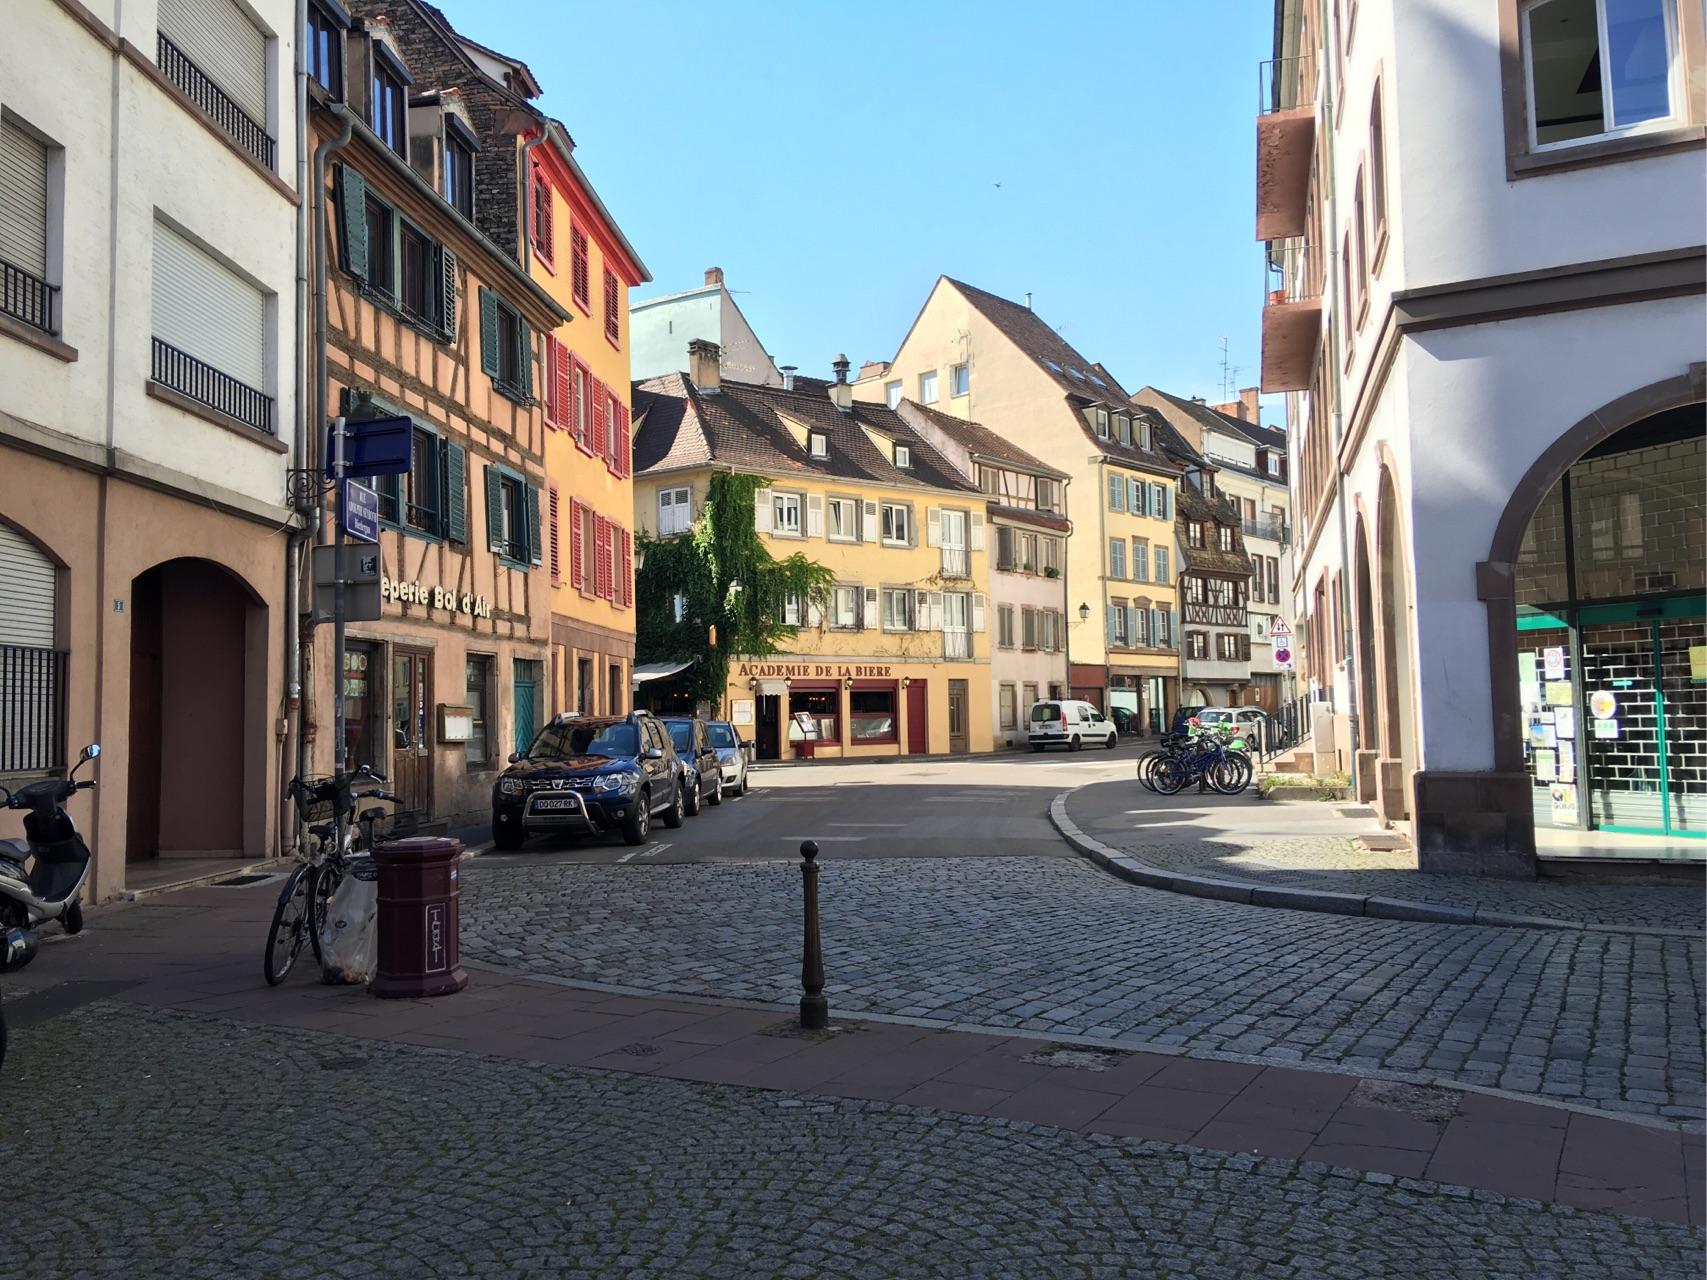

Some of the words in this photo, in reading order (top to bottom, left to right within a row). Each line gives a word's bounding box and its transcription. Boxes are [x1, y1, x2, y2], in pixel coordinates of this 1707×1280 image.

[382, 577, 429, 604] eperie
[434, 585, 457, 611] Bol
[462, 592, 491, 618] d'Air
[738, 663, 810, 677] ACADEMIE
[815, 666, 832, 677] DE
[838, 666, 852, 677] LA
[855, 666, 892, 677] BIERE
